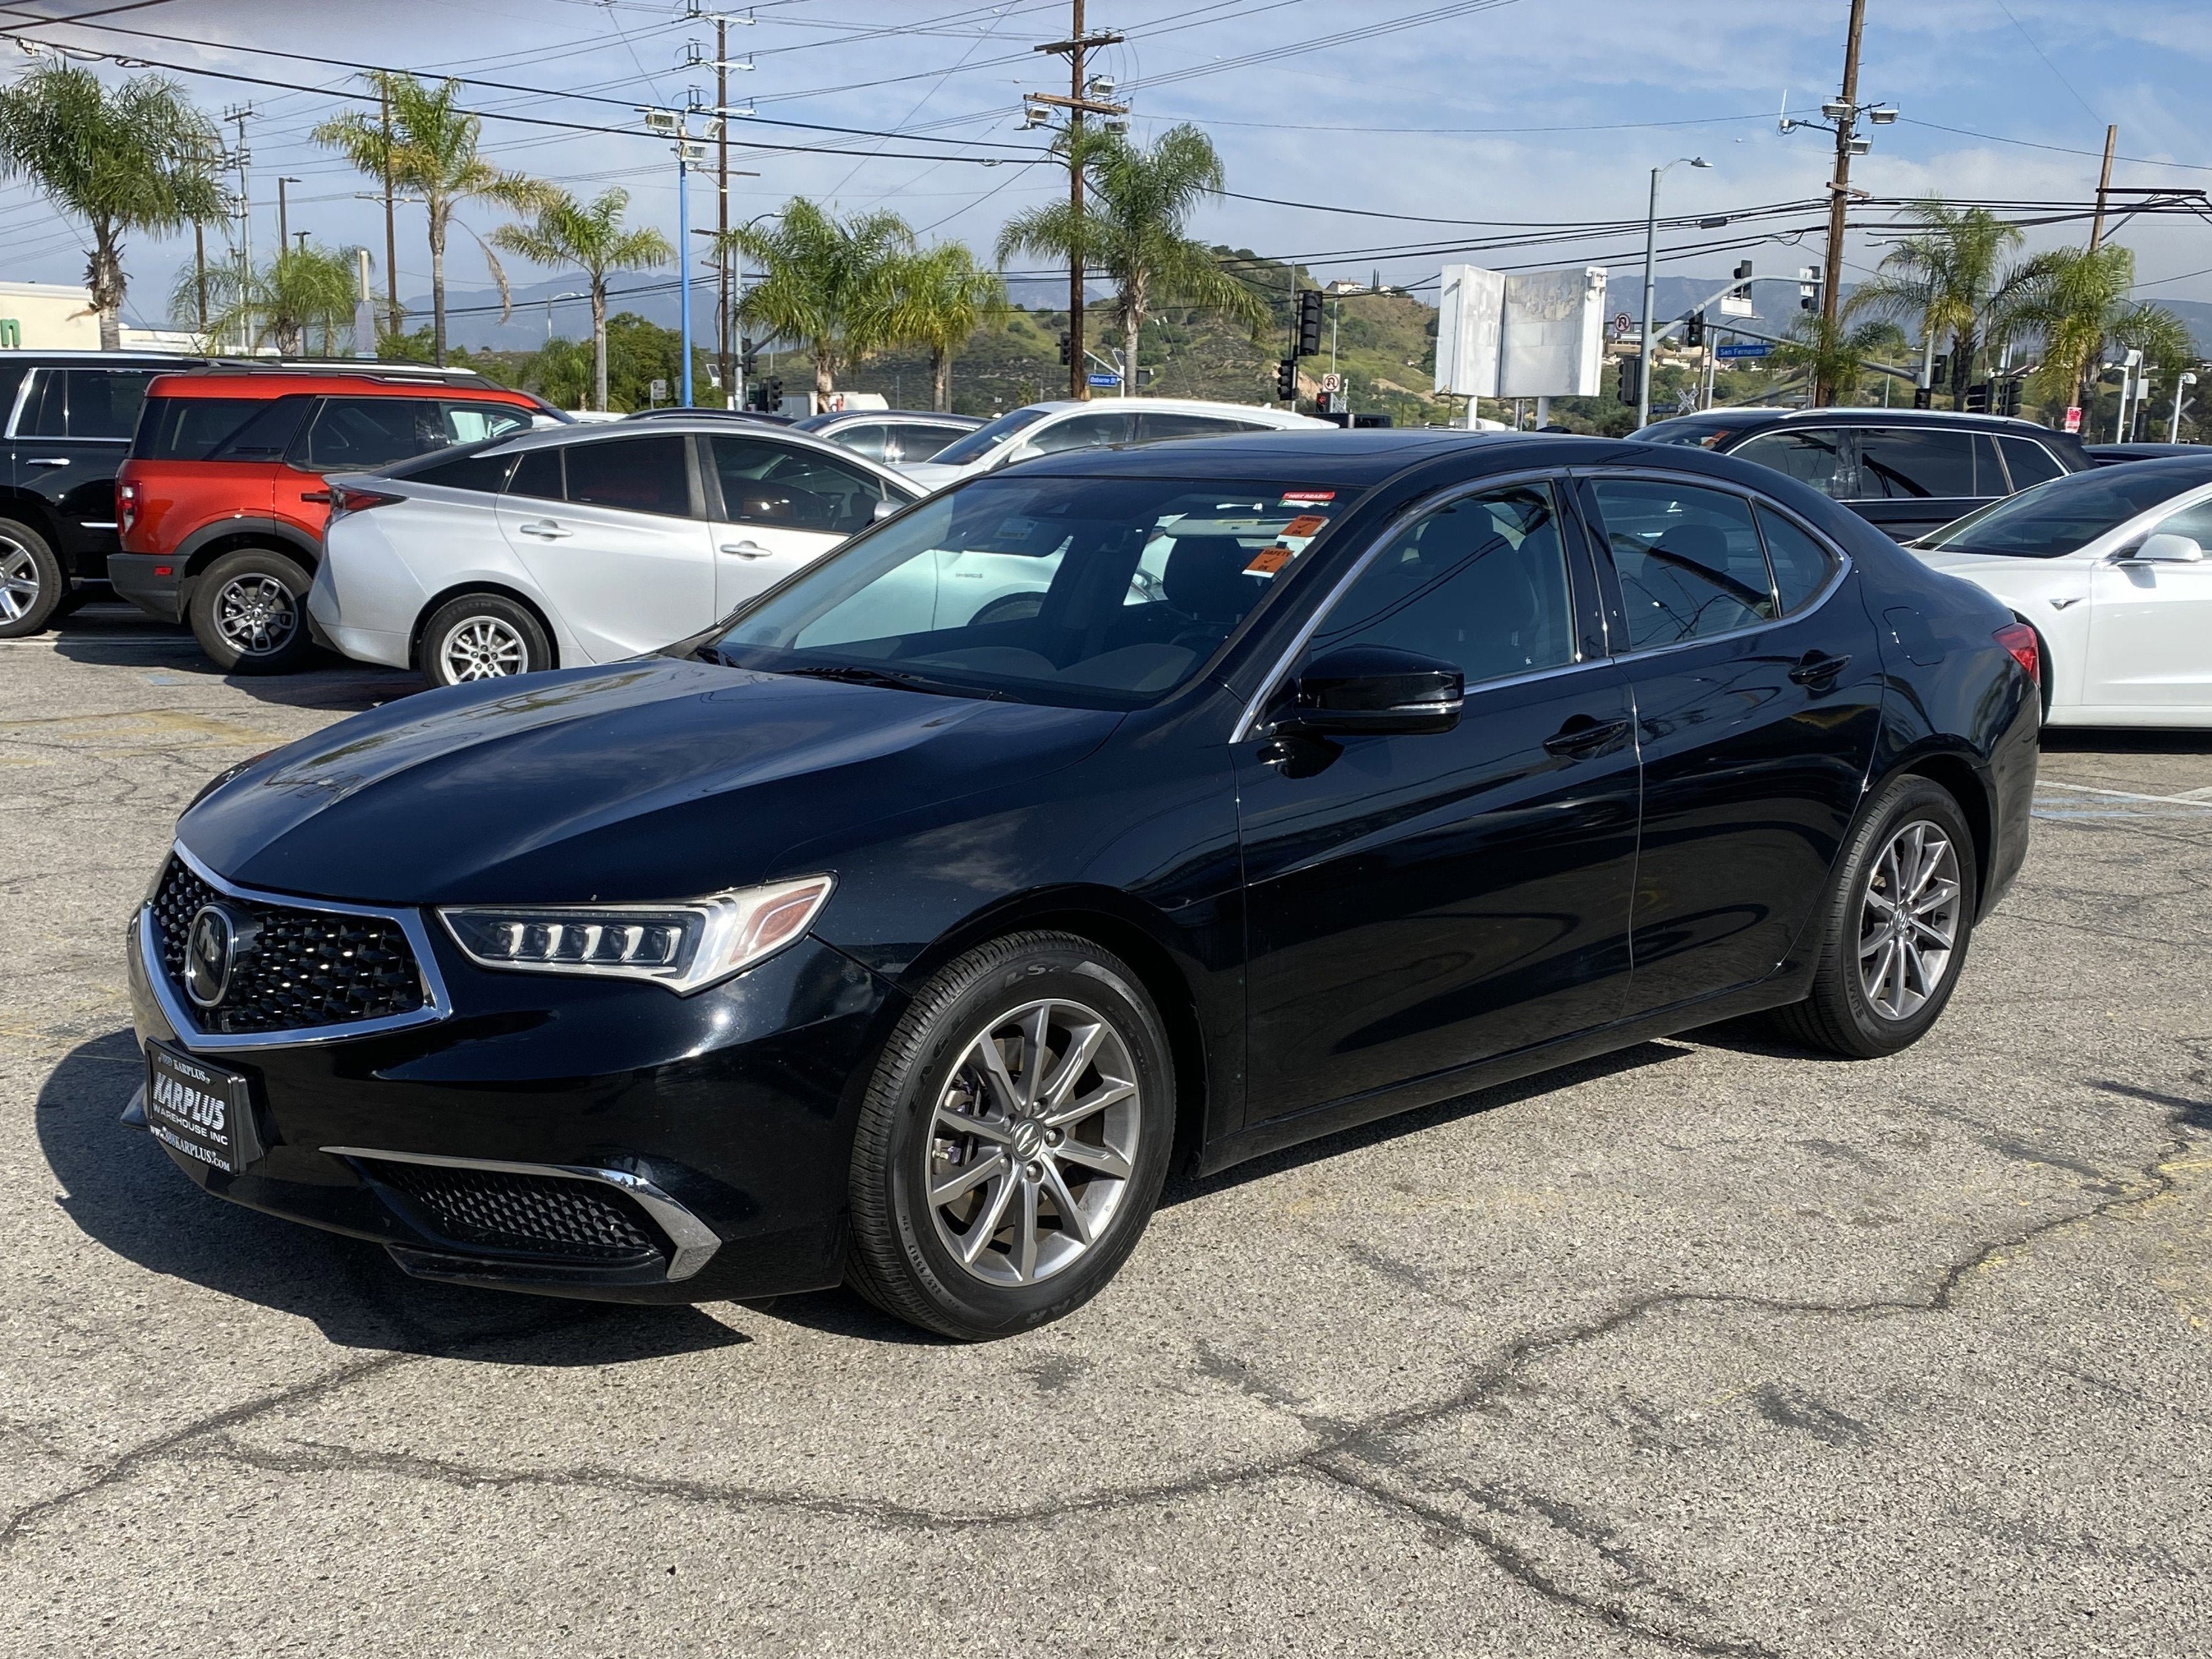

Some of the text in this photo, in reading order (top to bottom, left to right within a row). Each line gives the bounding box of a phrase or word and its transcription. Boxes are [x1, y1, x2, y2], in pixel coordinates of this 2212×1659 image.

[173, 1059, 206, 1082] KARPLUS
[154, 1072, 225, 1130] KARPLUS
[152, 1102, 228, 1146] WAREHOUSE INC
